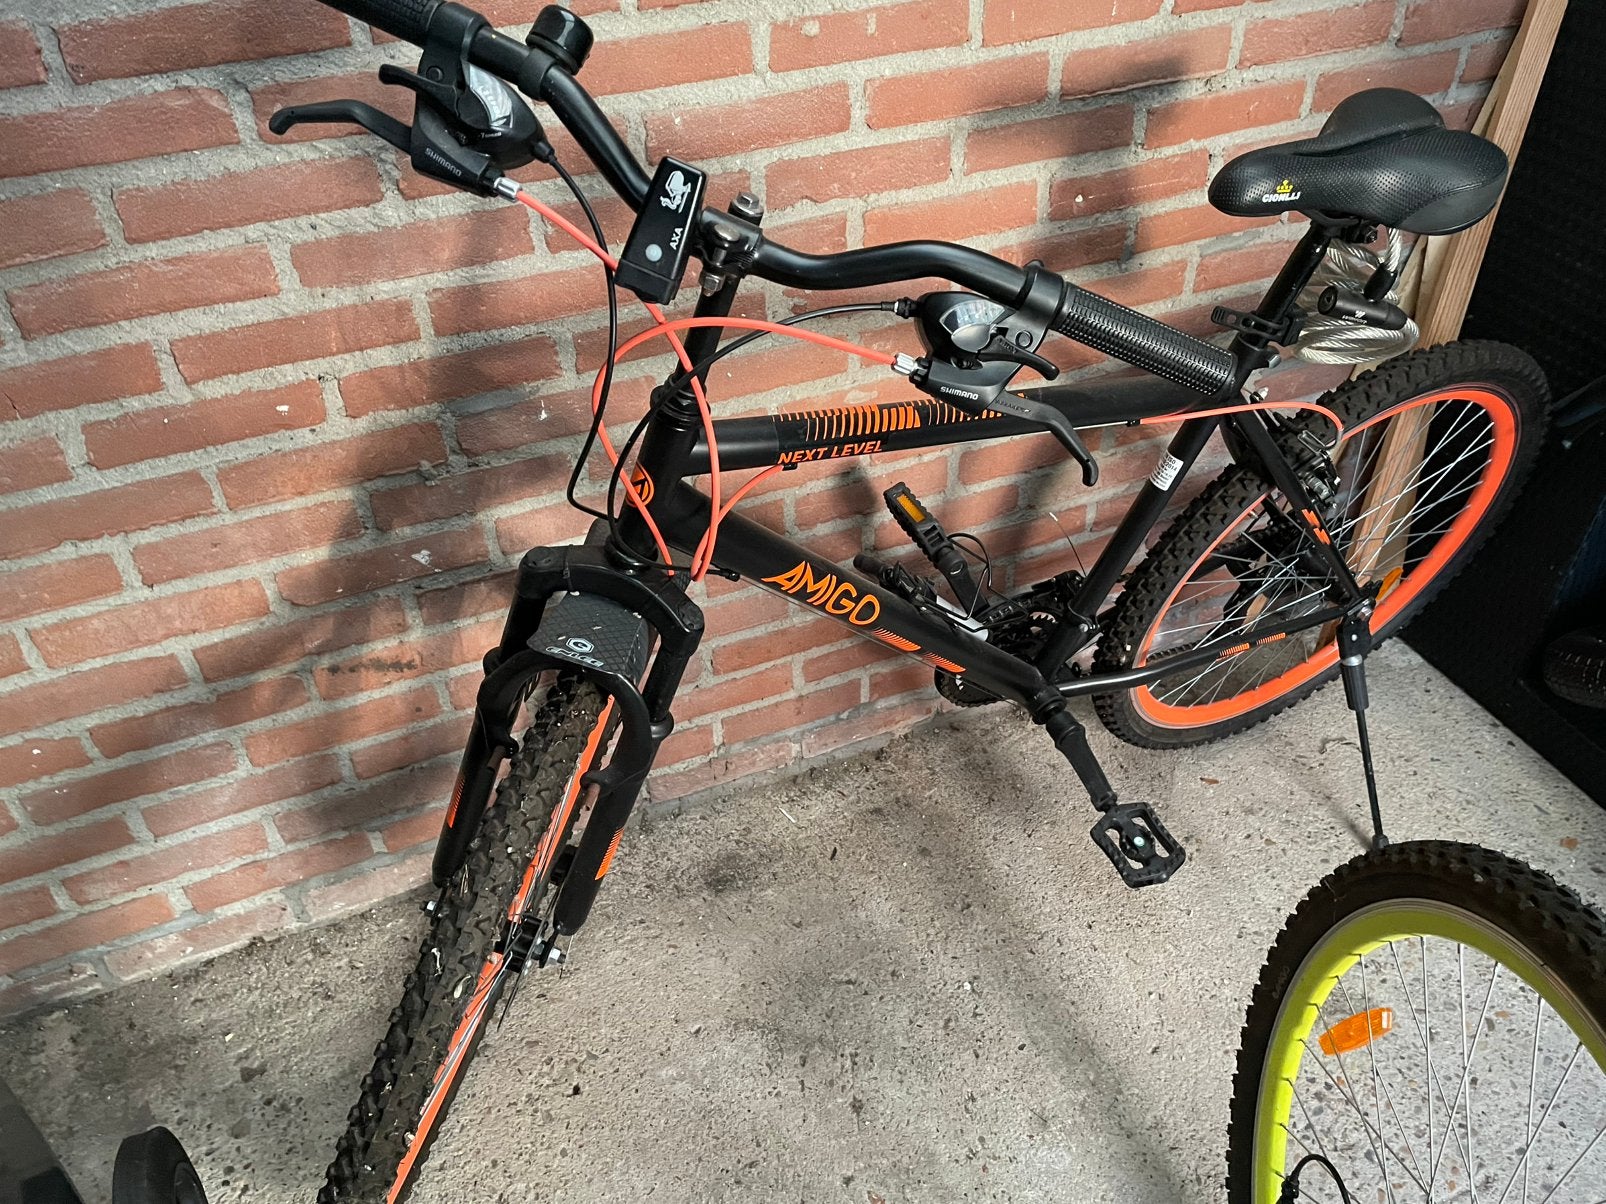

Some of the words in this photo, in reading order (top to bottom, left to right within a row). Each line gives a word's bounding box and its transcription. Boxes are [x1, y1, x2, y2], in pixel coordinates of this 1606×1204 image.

[425, 147, 462, 177] SHIMANO
[669, 227, 684, 251] AXA
[940, 386, 979, 401] SHIMANO
[777, 447, 828, 465] NEXT
[830, 440, 883, 459] LEVEL
[761, 560, 880, 625] AMIGO
